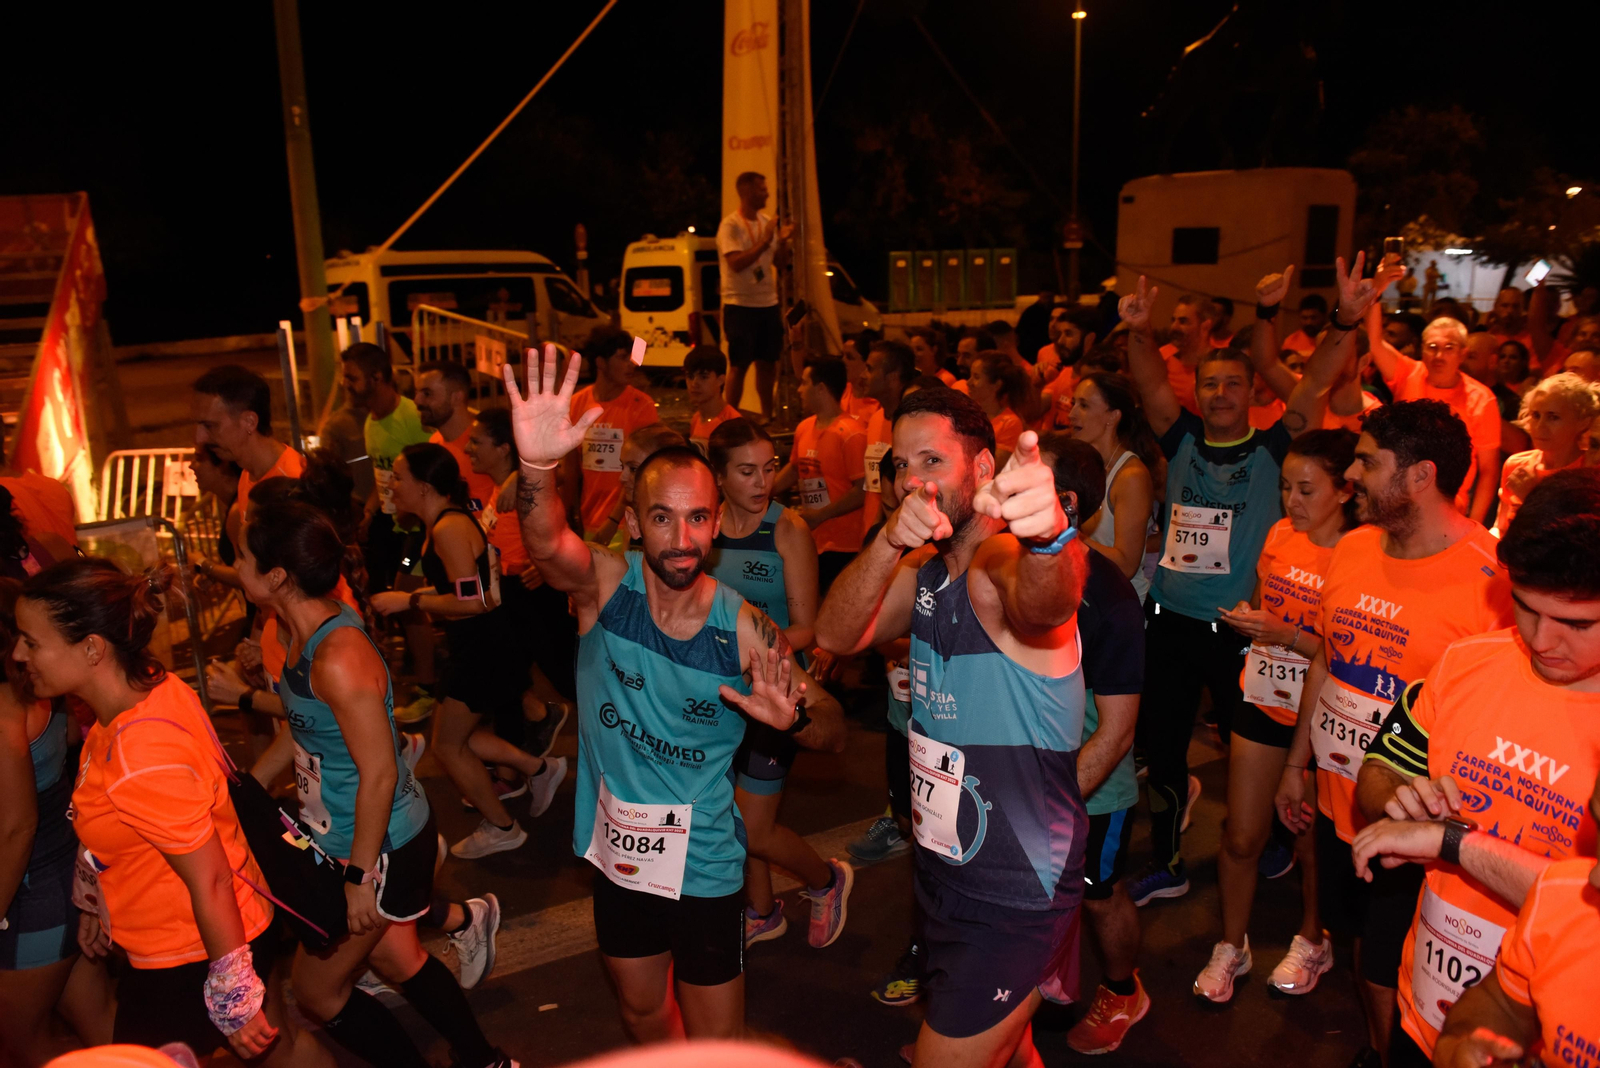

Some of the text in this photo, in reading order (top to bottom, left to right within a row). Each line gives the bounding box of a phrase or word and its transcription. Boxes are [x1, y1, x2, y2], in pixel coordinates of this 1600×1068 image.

[588, 443, 615, 453] 20275
[1175, 529, 1209, 547] 5719
[743, 561, 769, 577] 365
[743, 574, 774, 584] TRAINING
[1285, 565, 1325, 590] XXXV
[1268, 573, 1322, 599] CARRERA NOCTU
[1354, 593, 1403, 620] XXXV
[1335, 606, 1368, 622] CARRERA
[1370, 616, 1410, 637] NOCTURNA
[1336, 615, 1407, 647] GUADALQUIVIR
[1257, 660, 1308, 684] 21311
[682, 698, 718, 719] 365
[682, 713, 719, 727] TRAINING
[620, 719, 706, 763] CLISIMED
[1320, 711, 1371, 752] 21316
[1487, 735, 1570, 786] XXXV
[910, 769, 935, 803] 277
[1450, 761, 1580, 831] DEL GUADALQUIVIR
[1456, 751, 1584, 816] CARRERA NOCTURNA
[604, 822, 666, 854] 12084
[648, 881, 676, 893] Cruzcampo
[1426, 940, 1482, 989] 1102
[1466, 949, 1495, 967] GUADALQU
[1557, 1025, 1600, 1063] CARR
